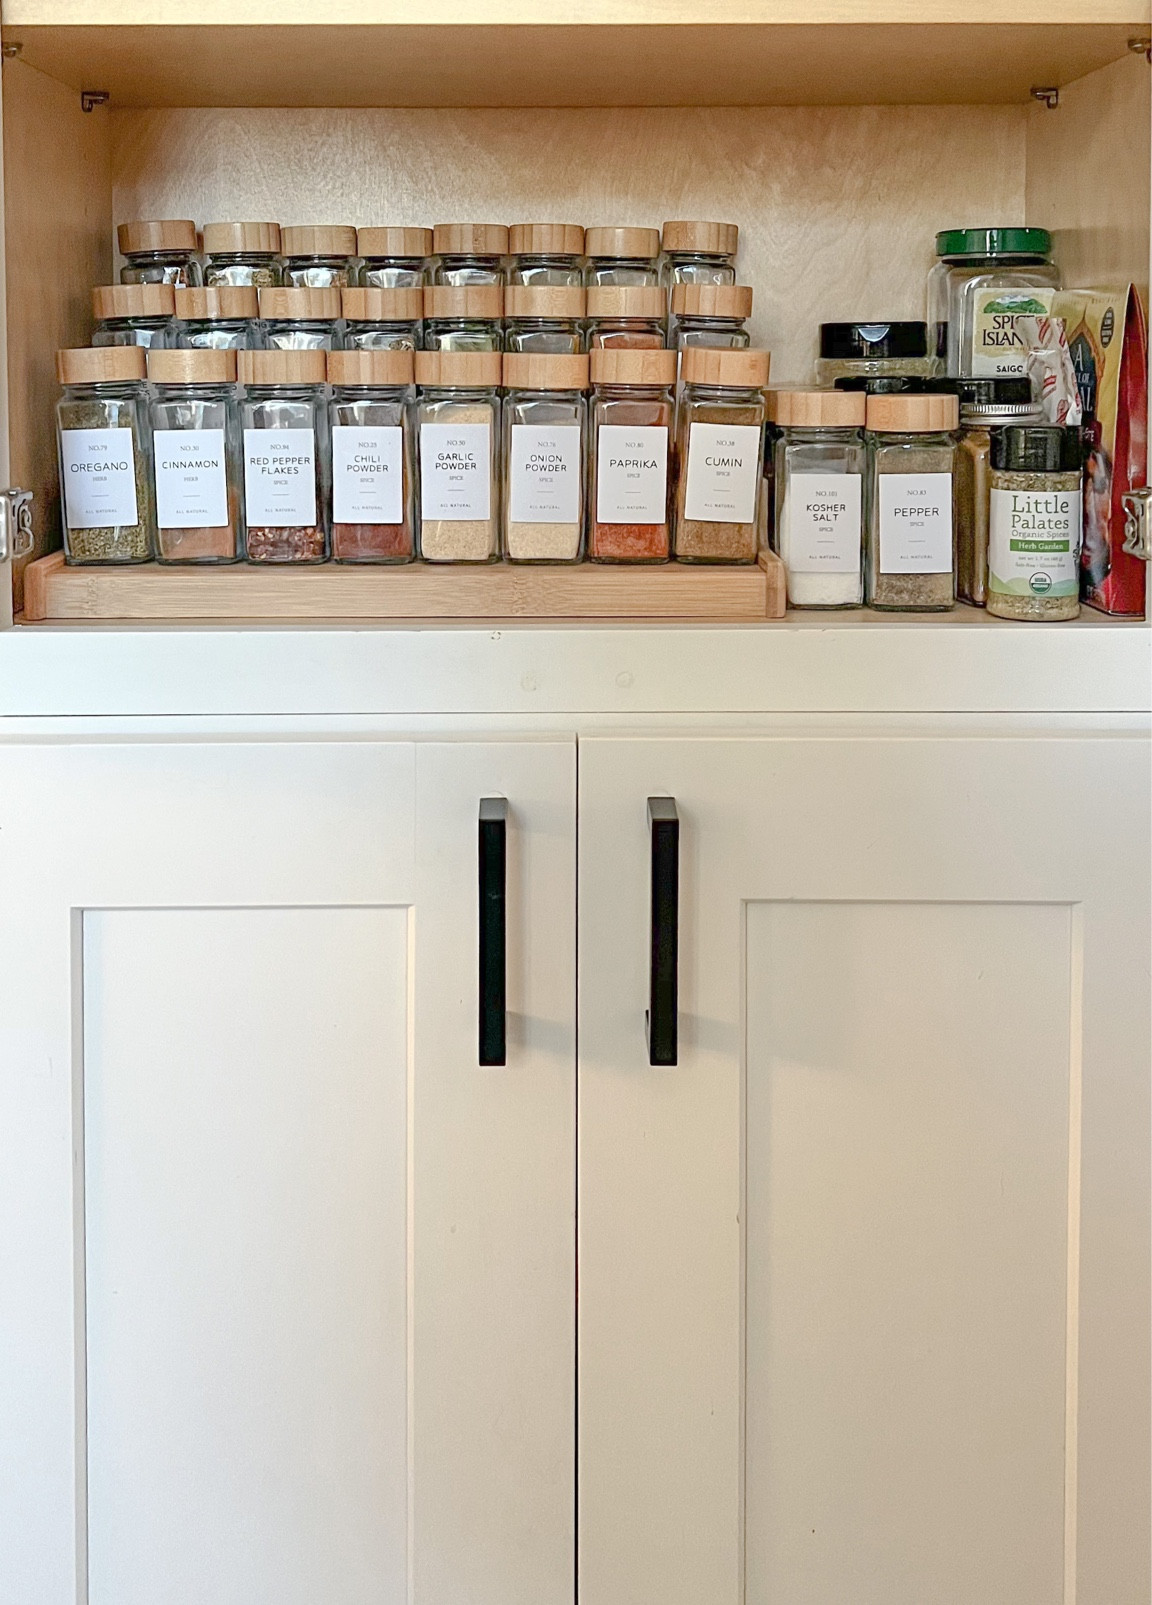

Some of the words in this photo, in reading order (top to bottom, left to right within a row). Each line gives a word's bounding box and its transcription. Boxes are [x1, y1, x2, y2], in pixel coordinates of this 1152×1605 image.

[993, 315, 1034, 329] SPI
[250, 457, 269, 465] RED
[273, 457, 310, 465] PEPPER
[354, 455, 381, 463] CHILI
[438, 453, 473, 461] GARLIC
[162, 460, 219, 469] CINNAMON
[435, 462, 477, 470] POWDER
[610, 460, 658, 469] PAPRIKA
[705, 457, 742, 467] CUMIN
[70, 461, 128, 473] OREGANO
[526, 464, 567, 472] POWDER
[807, 504, 846, 512] KOSHER
[1012, 495, 1069, 514] Little
[894, 508, 939, 517] PEPPER
[1012, 515, 1069, 529] Palates
[1012, 530, 1045, 539] Organic
[1047, 531, 1069, 540] Spices
